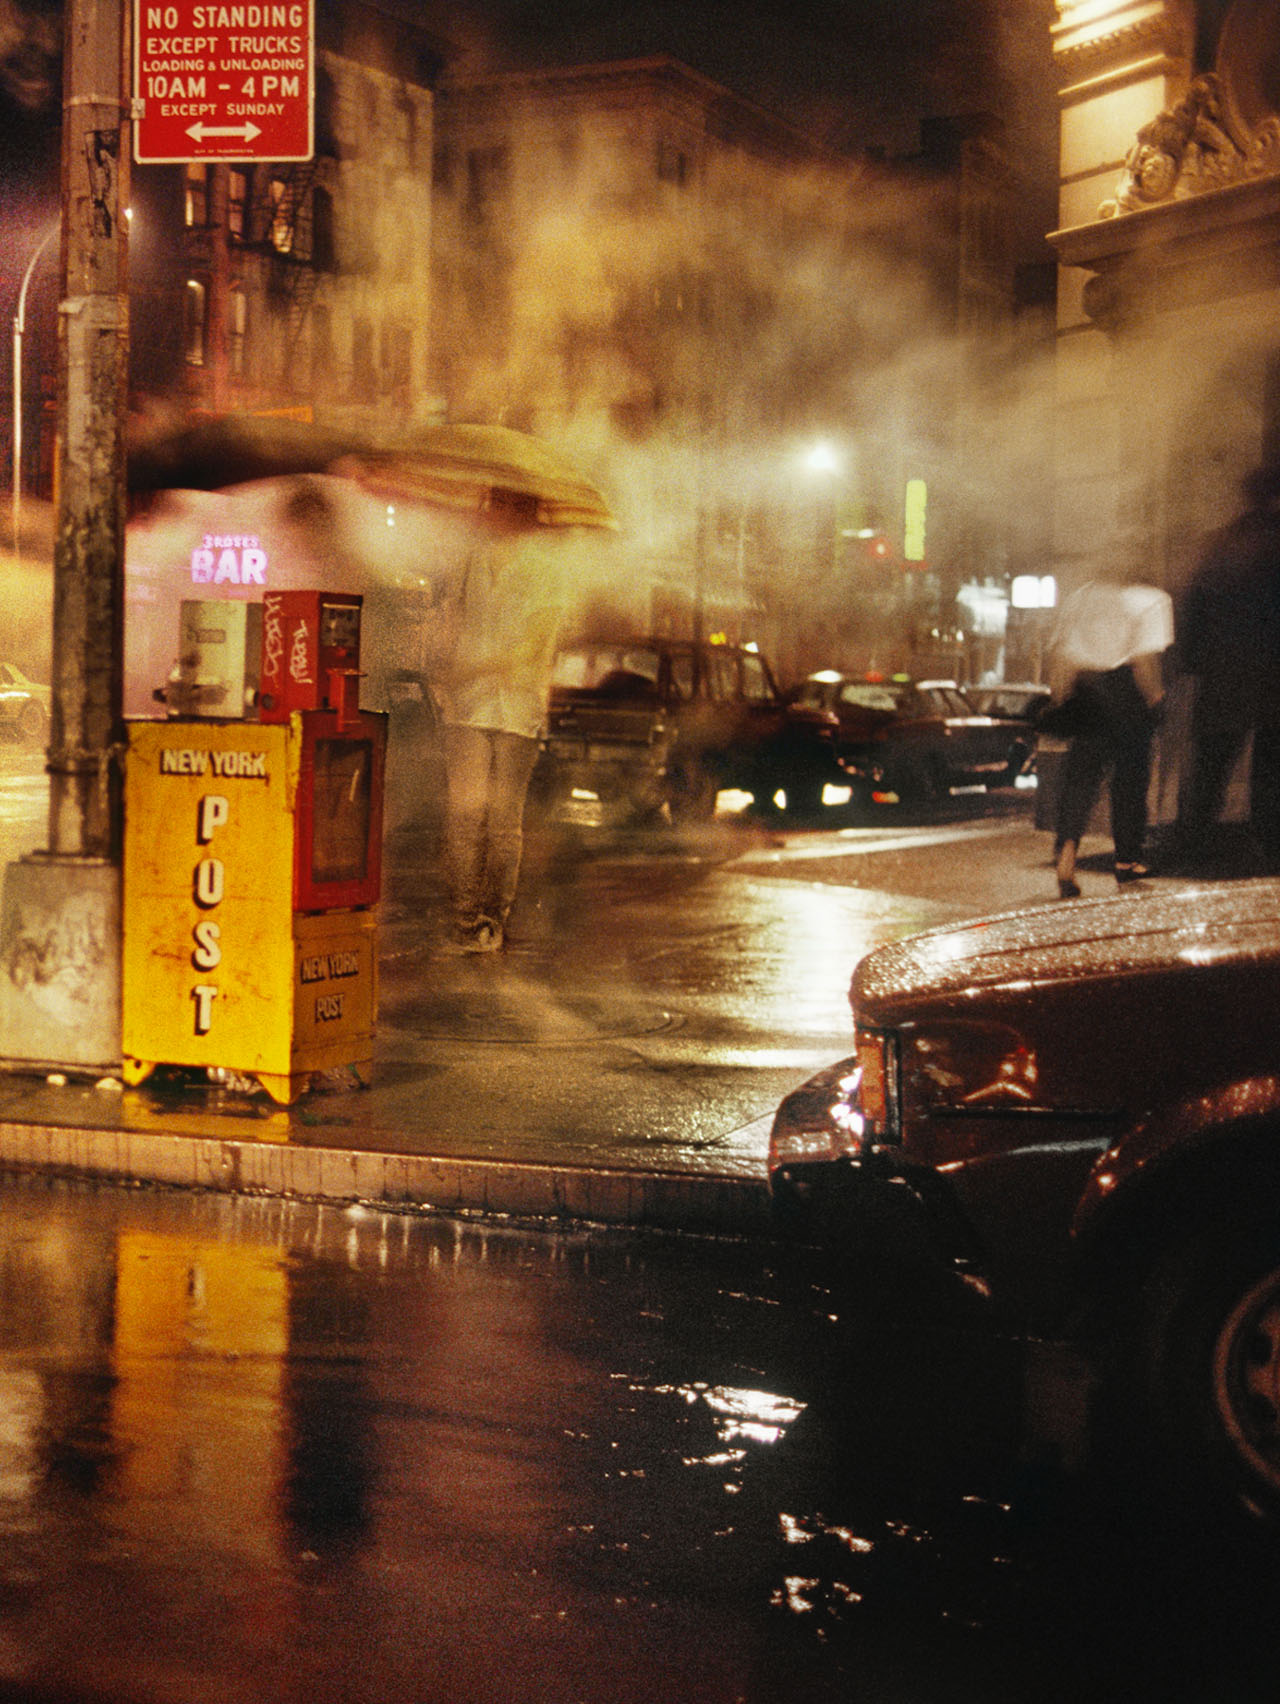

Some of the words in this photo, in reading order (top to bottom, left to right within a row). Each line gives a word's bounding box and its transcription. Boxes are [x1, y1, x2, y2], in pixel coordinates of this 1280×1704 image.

[147, 7, 178, 29] NO
[192, 6, 303, 28] STANDING
[146, 37, 218, 54] EXCEPT
[228, 36, 301, 54] TRUCKS
[143, 60, 204, 72] LOADING
[207, 61, 216, 71] &
[220, 59, 305, 71] UNLOADING
[147, 76, 206, 98] 10AM
[161, 104, 217, 116] EXCEPT
[226, 103, 285, 115] SUNDAY
[191, 549, 268, 585] BAR
[160, 749, 208, 776] NEW
[210, 751, 267, 778] YORK
[191, 795, 229, 1035] POST
[301, 958, 326, 985] NEW
[327, 949, 360, 980] YORK
[315, 993, 345, 1023] POST
